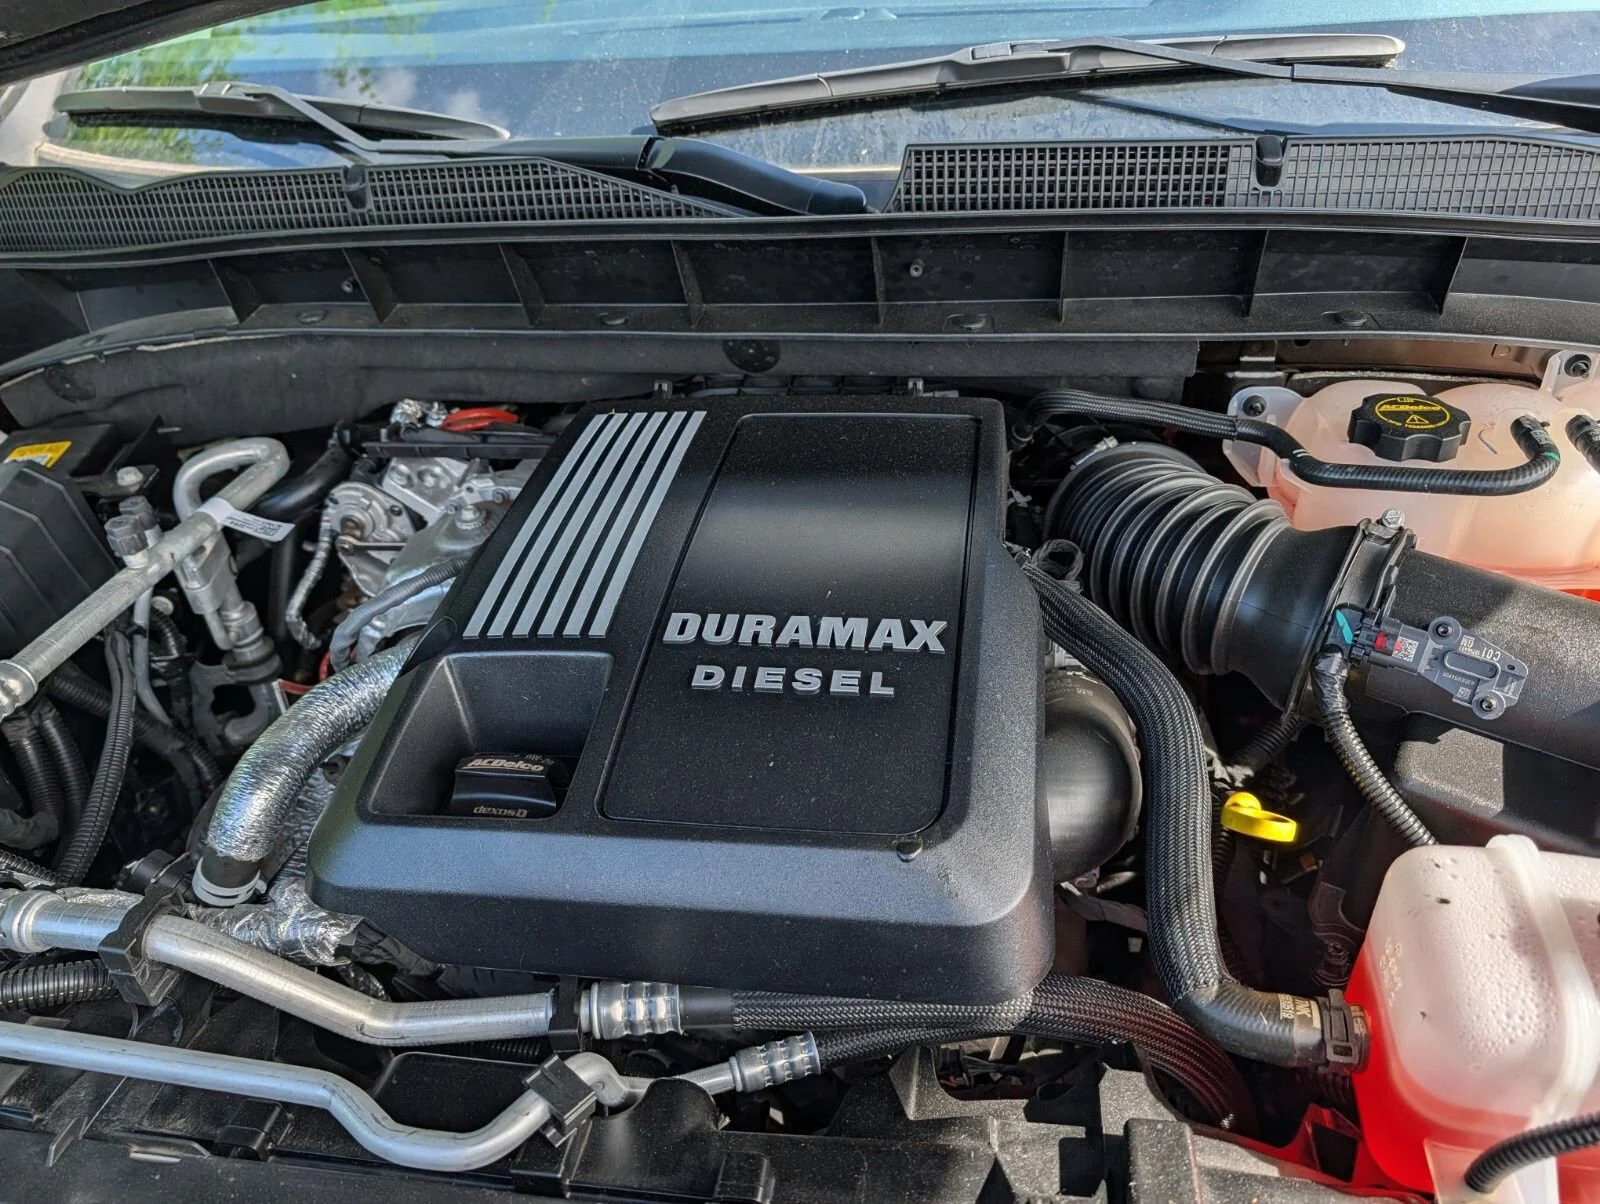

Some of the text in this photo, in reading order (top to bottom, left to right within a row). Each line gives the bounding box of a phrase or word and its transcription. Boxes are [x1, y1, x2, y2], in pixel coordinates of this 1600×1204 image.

[662, 612, 947, 654] DURAMAX
[691, 664, 895, 698] DIESEL
[462, 758, 544, 772] ACDelco
[473, 805, 528, 818] dexosD
